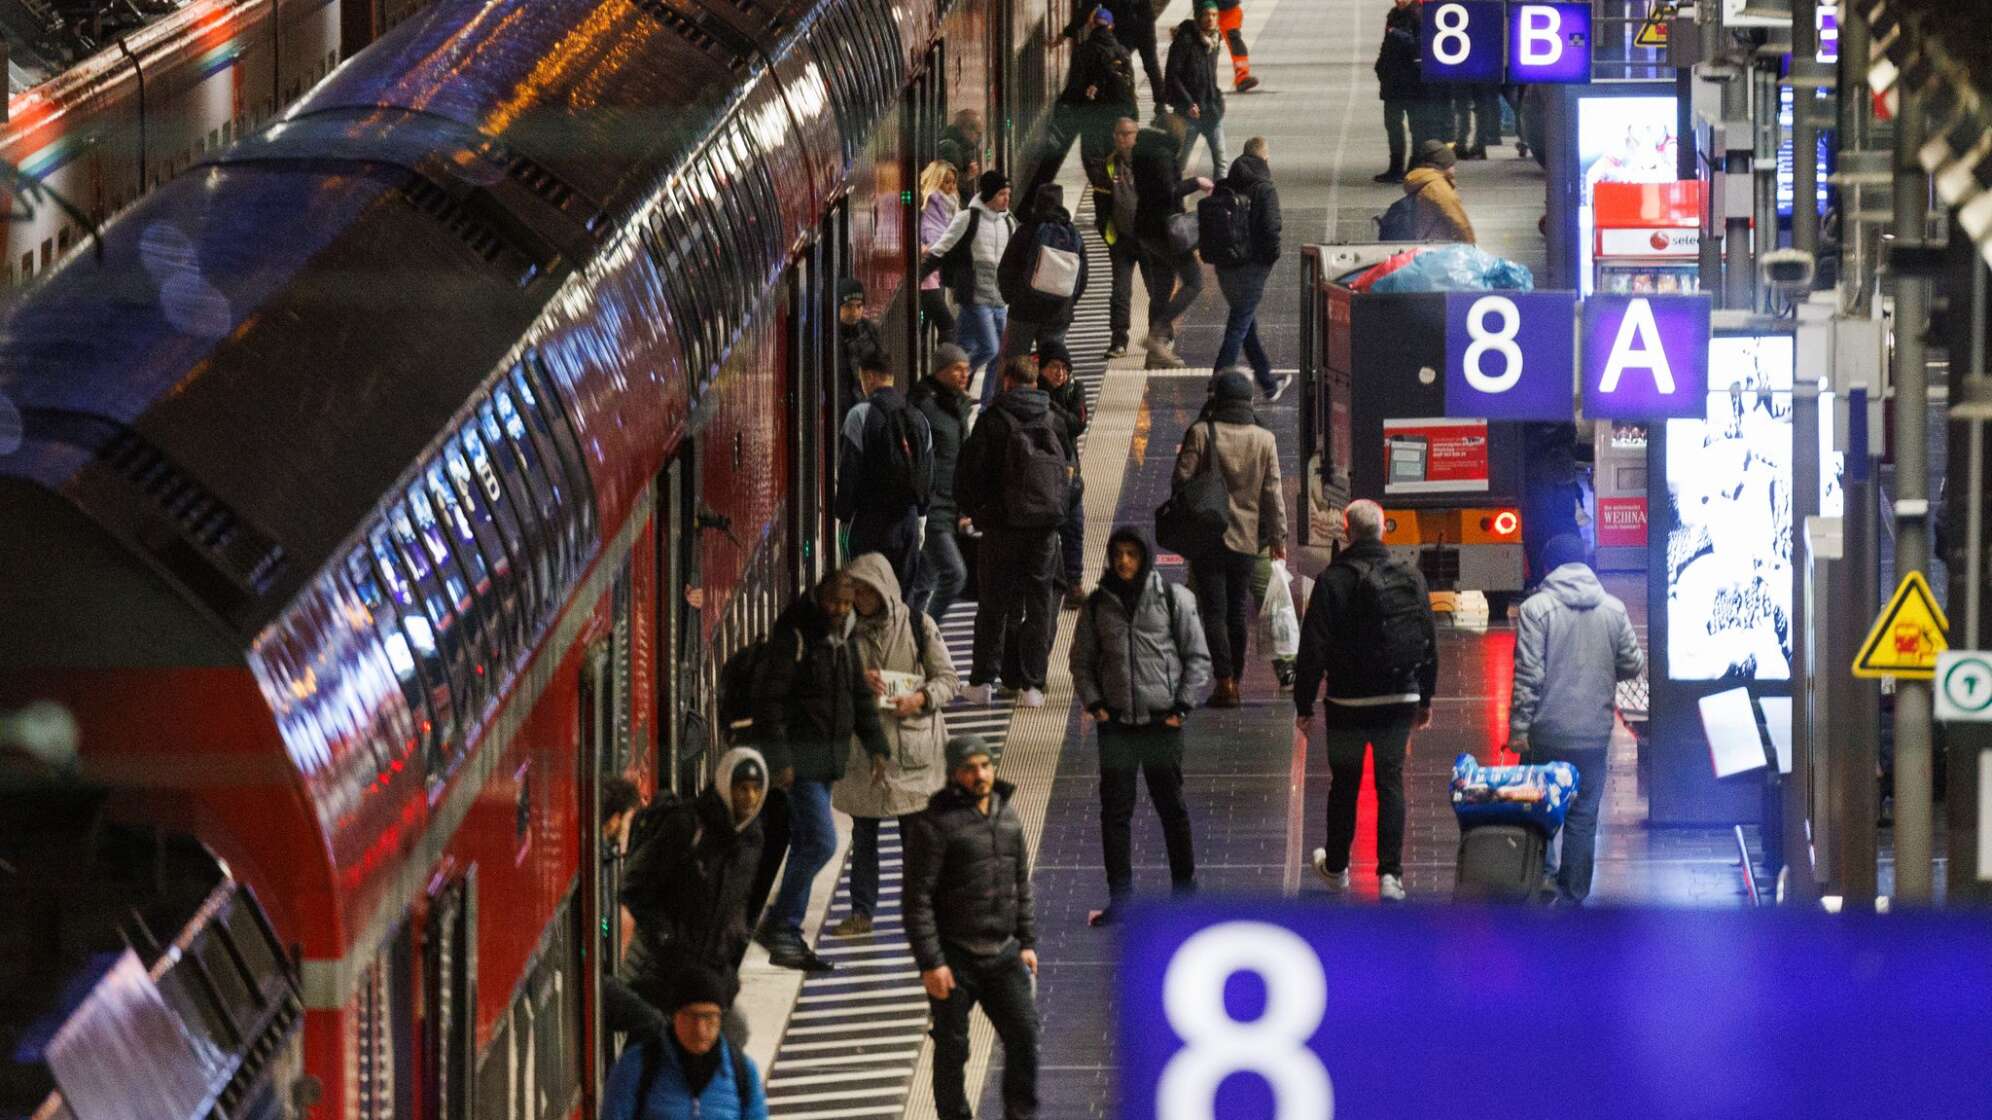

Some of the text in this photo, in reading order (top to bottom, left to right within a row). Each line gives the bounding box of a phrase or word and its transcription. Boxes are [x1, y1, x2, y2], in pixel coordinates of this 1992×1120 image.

[1433, 3, 1471, 65] 8
[1520, 5, 1562, 65] B
[1672, 236, 1699, 246] sele
[1463, 295, 1523, 393] 8
[1598, 298, 1676, 394] A
[1604, 511, 1648, 524] WEIHNA
[1154, 920, 1335, 1120] 8
